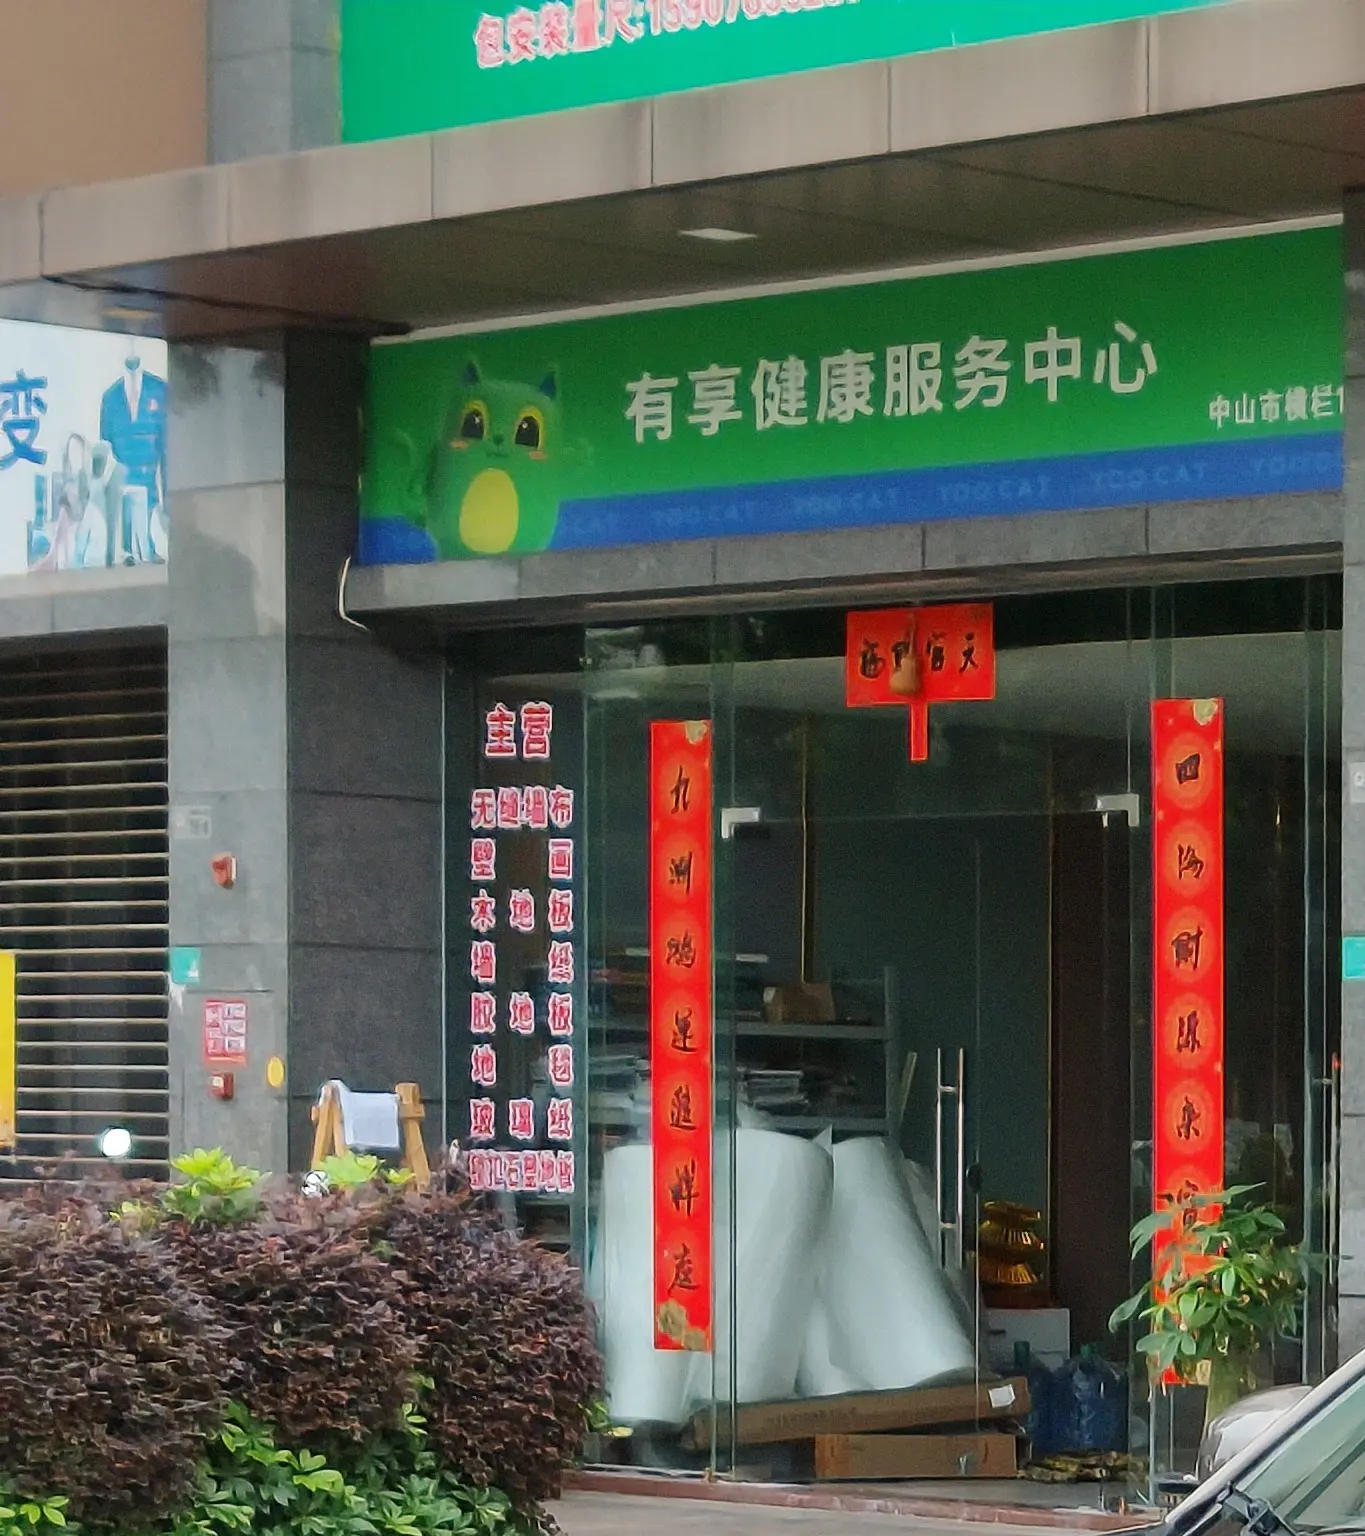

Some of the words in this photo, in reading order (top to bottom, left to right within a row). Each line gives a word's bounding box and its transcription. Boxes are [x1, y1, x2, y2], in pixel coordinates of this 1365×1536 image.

[625, 319, 1158, 444] 有享健康服务中心
[1208, 384, 1344, 430] 中山市横栏
[485, 702, 553, 758] 主营
[471, 889, 574, 933] 木地板
